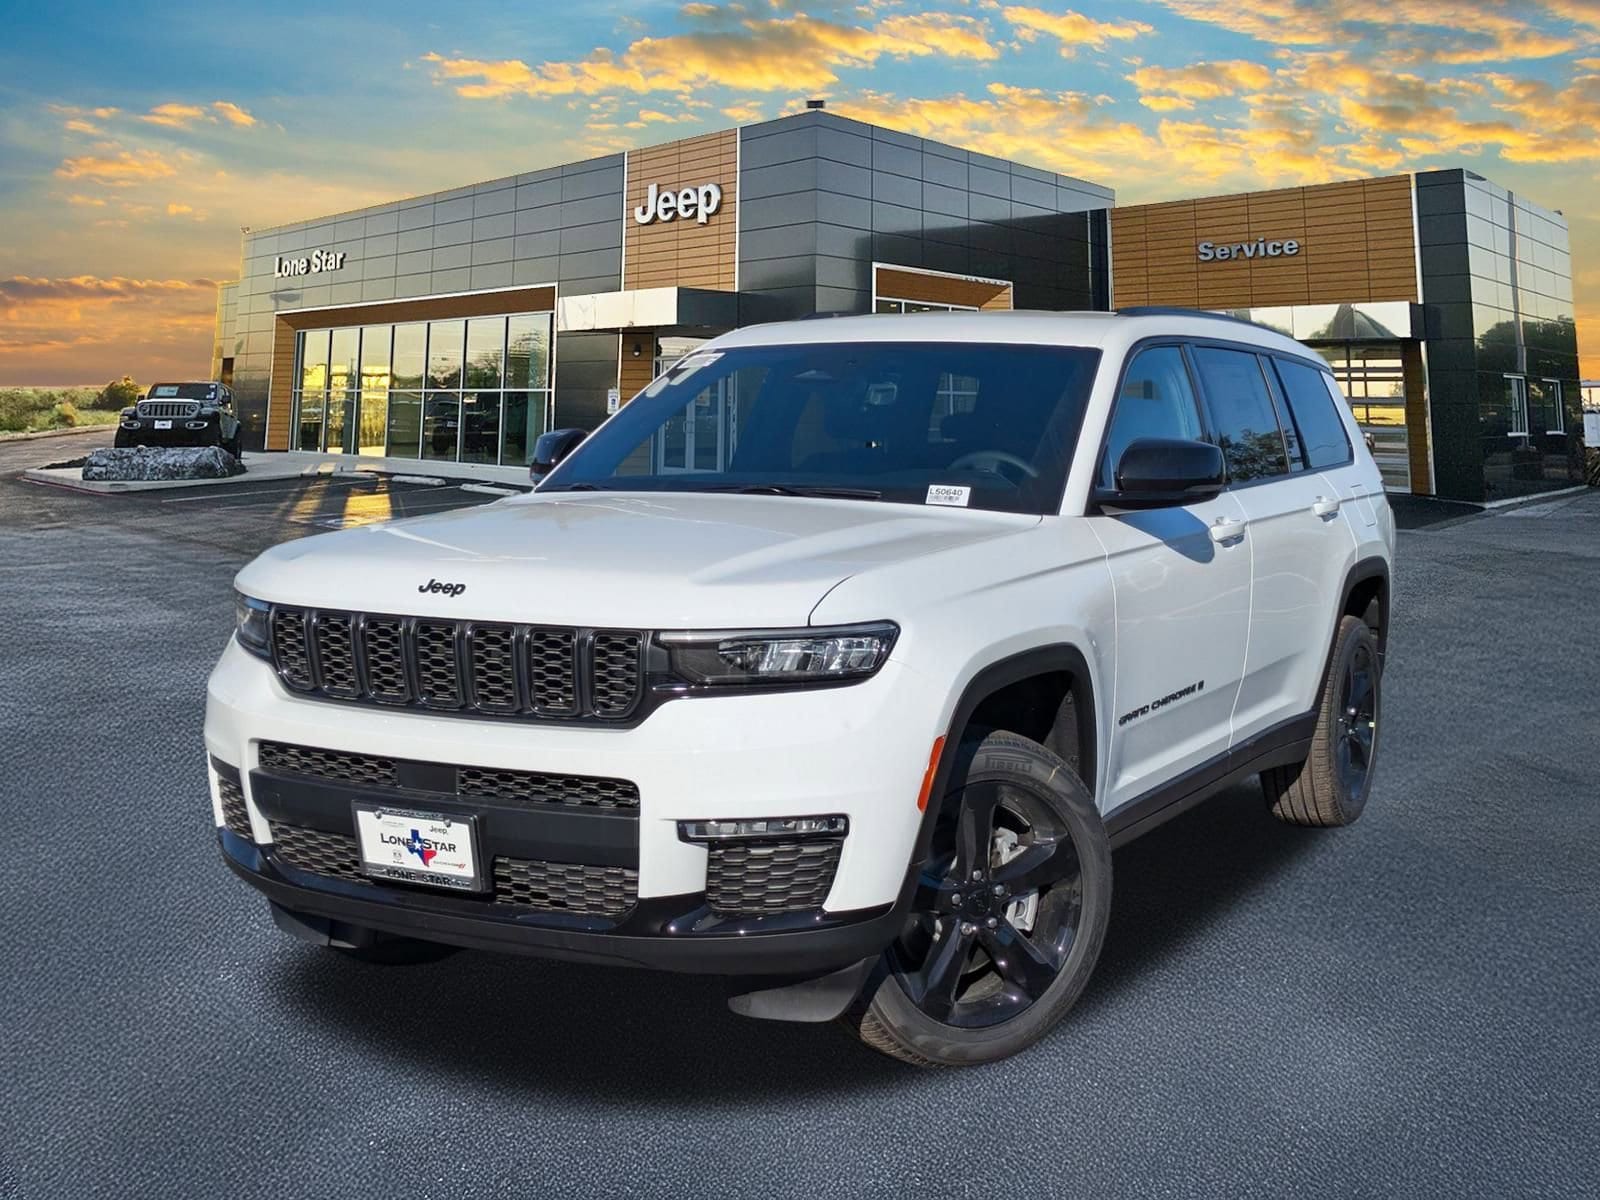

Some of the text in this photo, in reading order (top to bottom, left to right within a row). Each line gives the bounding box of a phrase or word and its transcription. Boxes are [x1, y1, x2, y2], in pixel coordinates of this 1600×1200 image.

[634, 182, 721, 225] Jeep
[1198, 237, 1299, 261] Service
[274, 249, 345, 278] Lone Star
[418, 578, 466, 598] Jeep
[380, 832, 457, 853] LONE STAR
